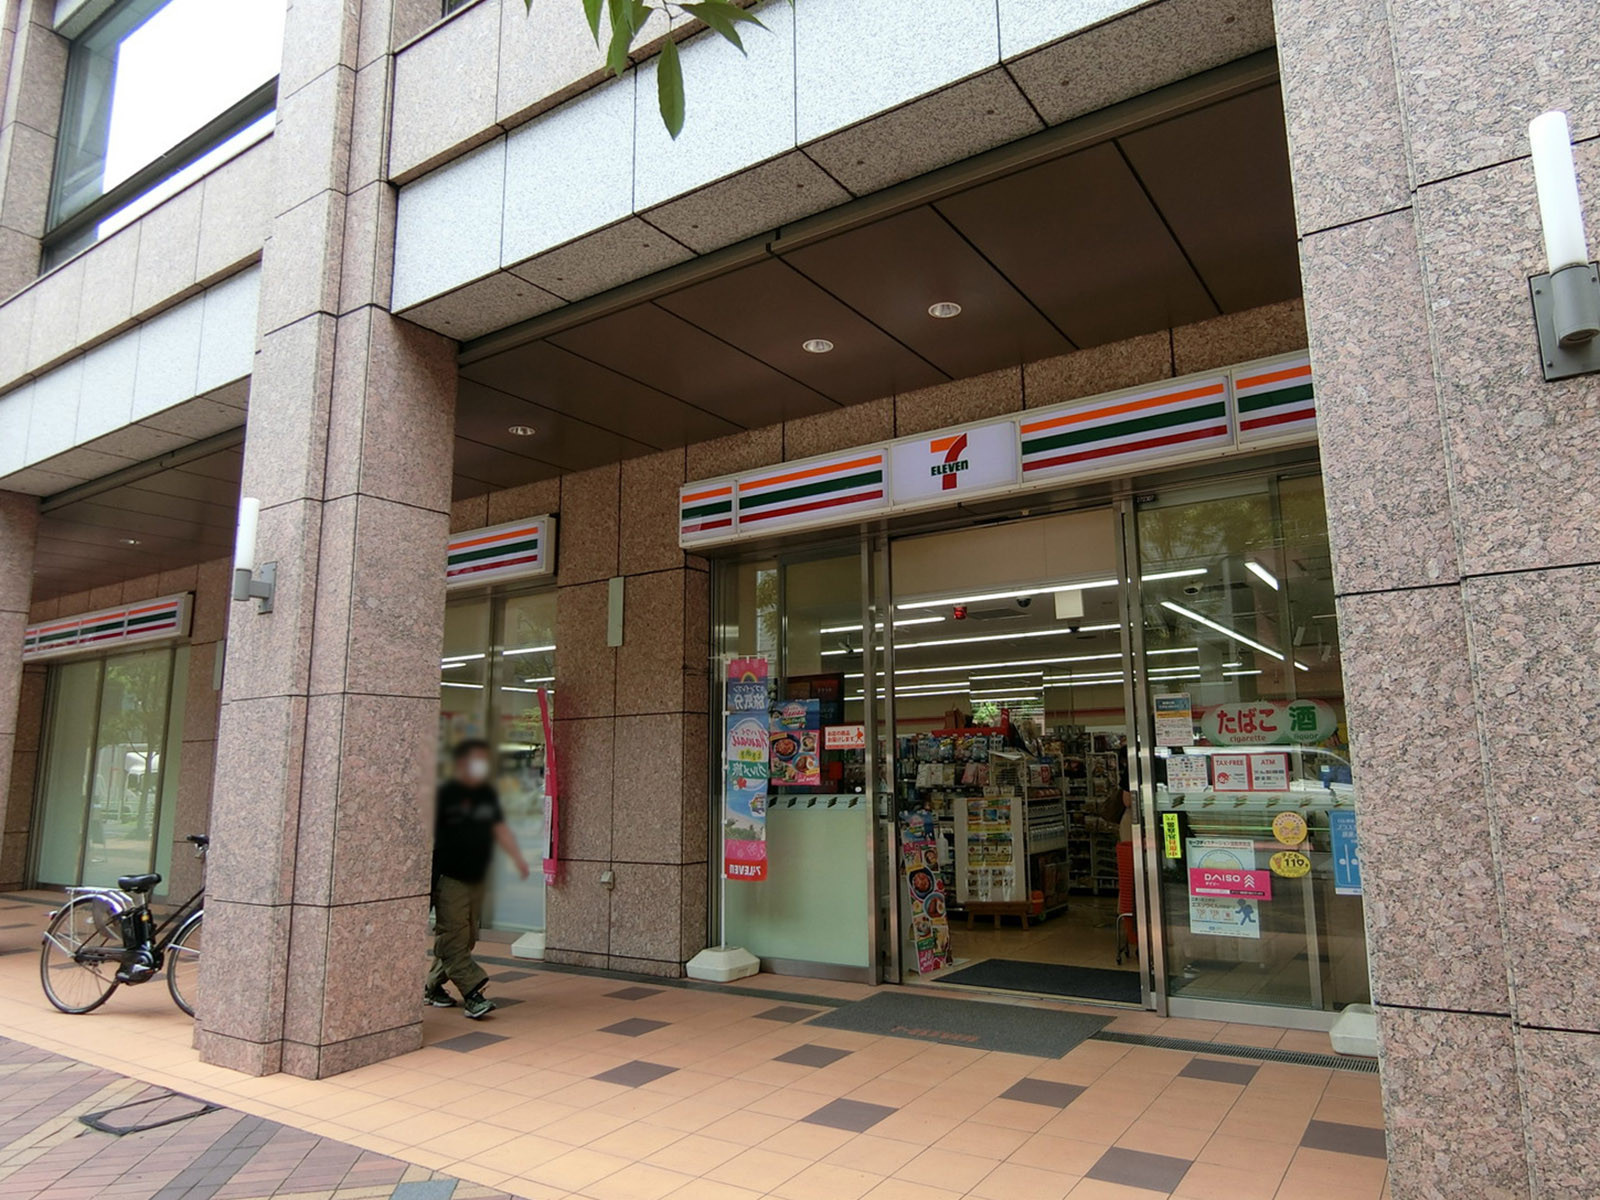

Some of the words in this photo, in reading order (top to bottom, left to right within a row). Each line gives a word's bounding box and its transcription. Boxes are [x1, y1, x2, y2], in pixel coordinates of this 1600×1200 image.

[930, 432, 968, 491] 7
[1217, 708, 1277, 734] たばこ
[1289, 706, 1317, 731] 酒
[1229, 734, 1266, 743] cigarette
[1293, 732, 1319, 741] liquor
[1204, 873, 1241, 882] DAISO
